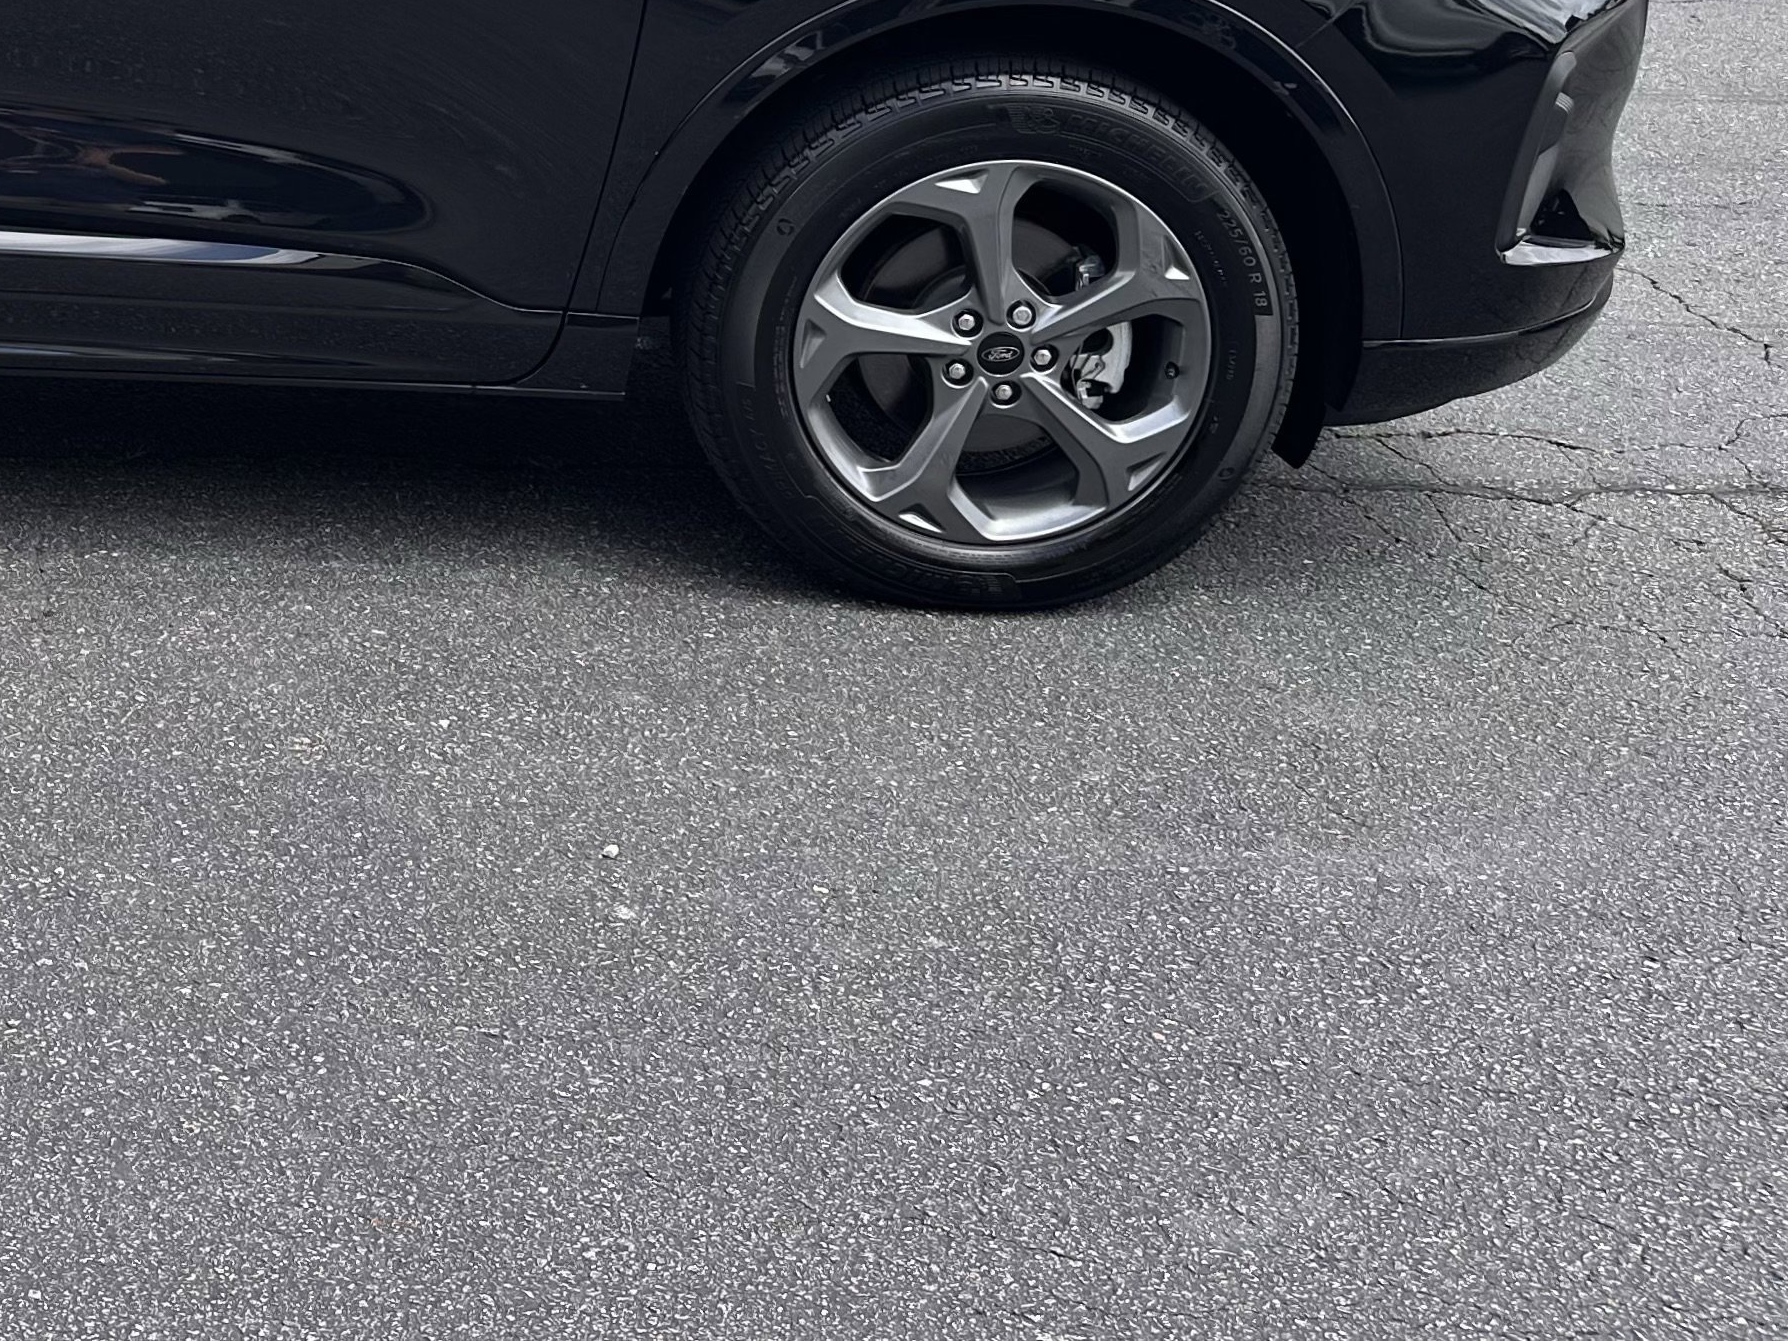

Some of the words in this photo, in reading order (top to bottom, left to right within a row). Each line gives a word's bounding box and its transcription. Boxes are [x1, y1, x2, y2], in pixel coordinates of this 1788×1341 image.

[1216, 210, 1256, 268] 225/60
[1249, 272, 1262, 284] R
[1253, 291, 1268, 307] 18
